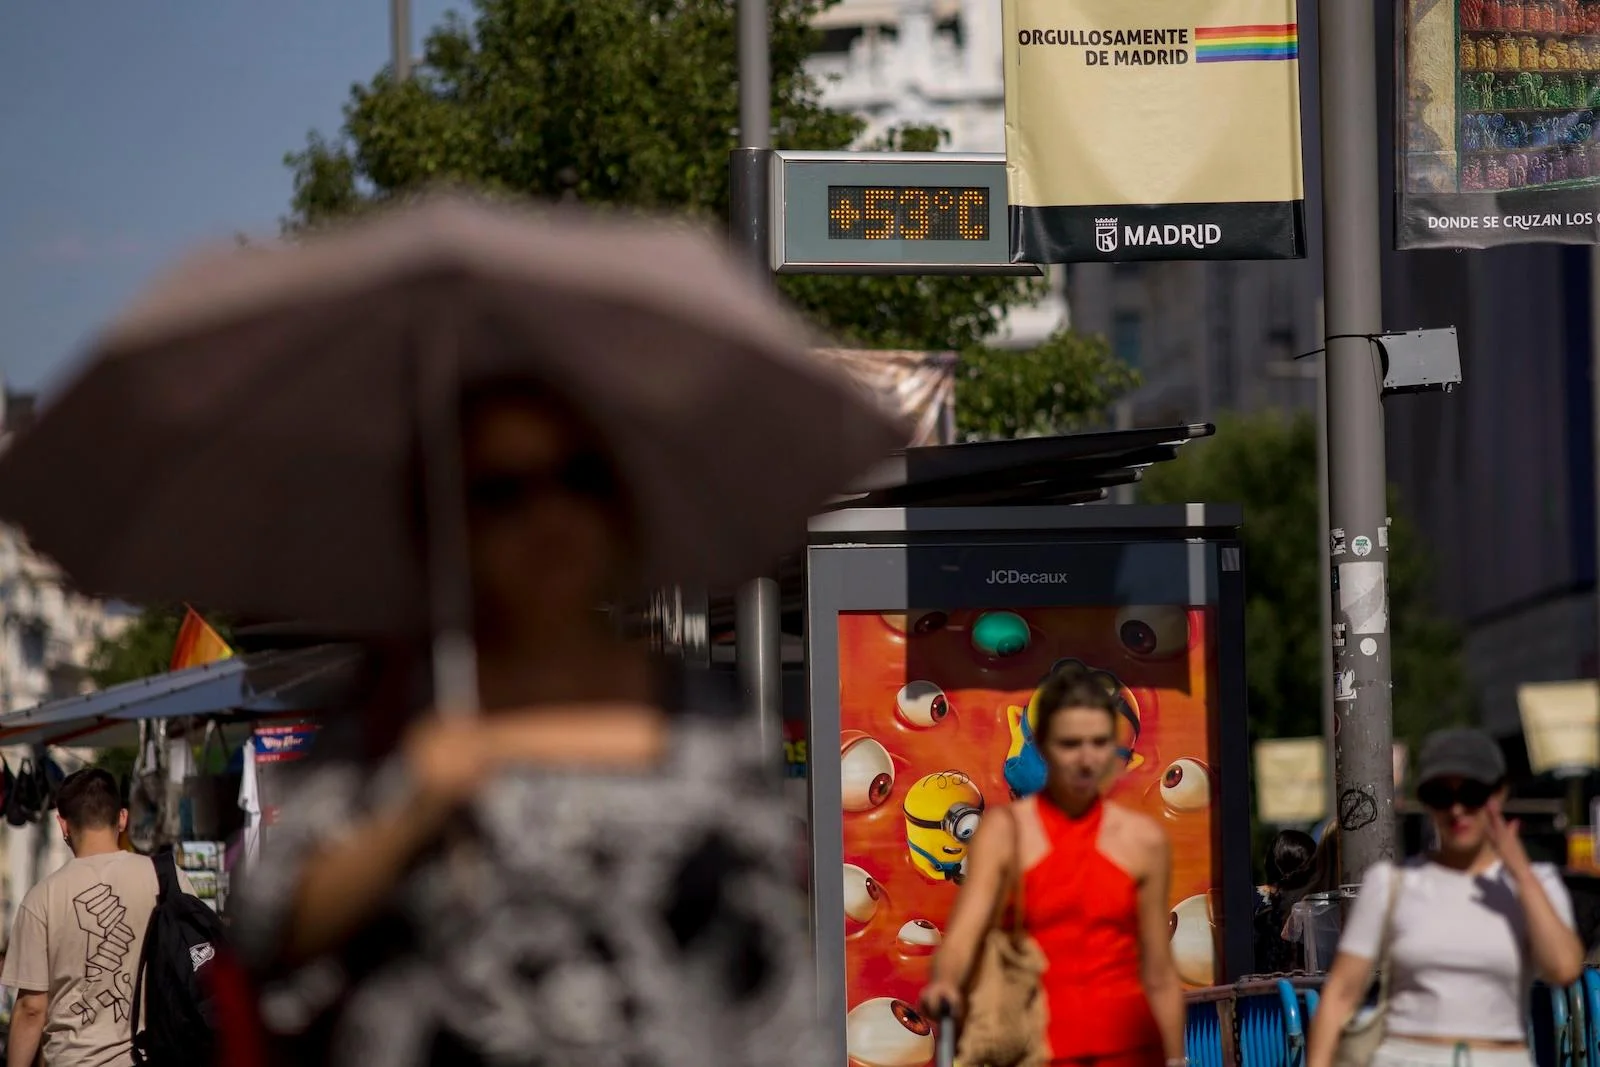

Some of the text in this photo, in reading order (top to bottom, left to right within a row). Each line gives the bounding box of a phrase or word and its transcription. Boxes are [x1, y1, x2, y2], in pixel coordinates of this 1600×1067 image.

[1018, 28, 1188, 46] ORGULLOSAMENTE
[1085, 49, 1188, 66] DE MADRID
[1428, 216, 1479, 229] DONDE
[1482, 216, 1499, 228] SE
[1503, 213, 1561, 230] CRUZAN
[1566, 212, 1593, 225] LOS
[1124, 224, 1221, 249] MADRID
[986, 570, 1068, 585] JCDecaux
